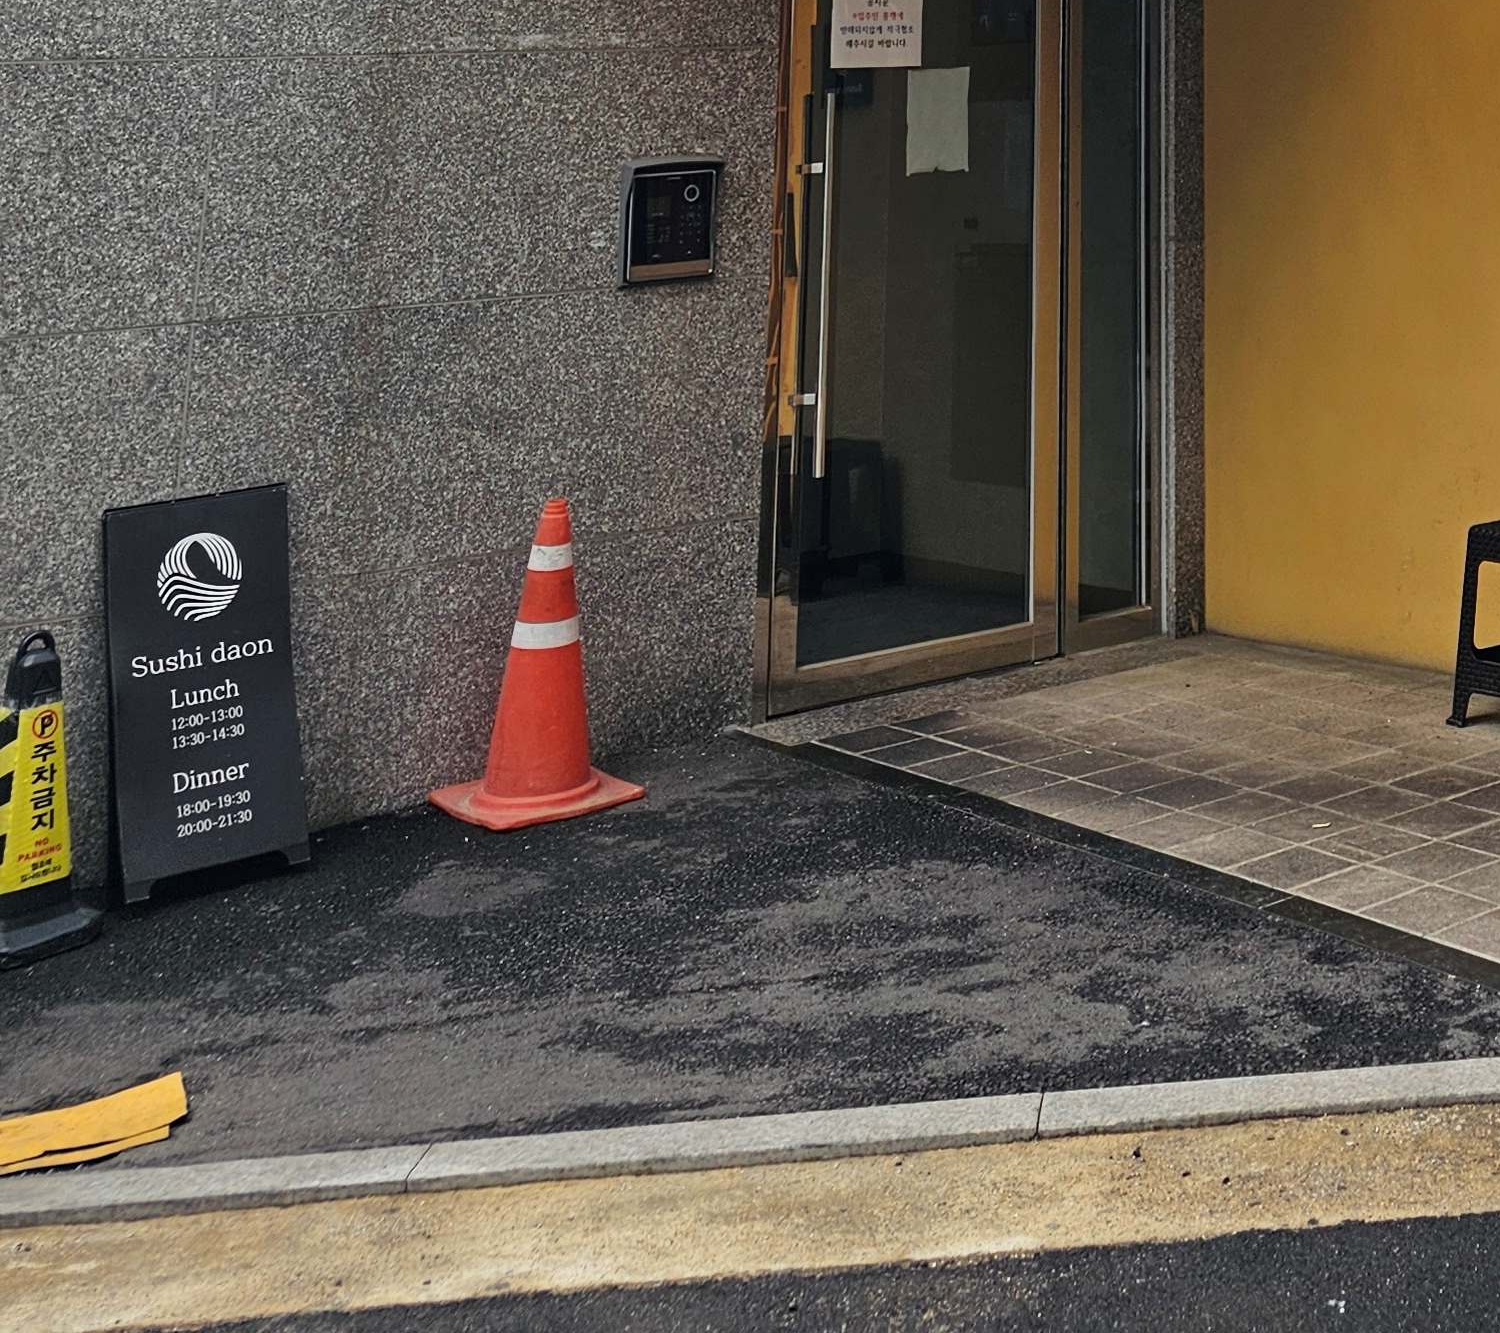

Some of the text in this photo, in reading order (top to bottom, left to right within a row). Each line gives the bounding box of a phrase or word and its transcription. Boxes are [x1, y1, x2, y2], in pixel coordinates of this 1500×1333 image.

[131, 637, 274, 678] Sushi daon
[170, 679, 240, 709] Lunch
[171, 705, 244, 731] 12:00-13:00
[172, 723, 245, 749] 13:30-14:30
[30, 740, 57, 831] 주차금지
[172, 762, 250, 794] Dinner
[177, 790, 251, 818] 18:00-19:30
[177, 809, 253, 837] 20:00-21:30
[35, 837, 49, 847] NO
